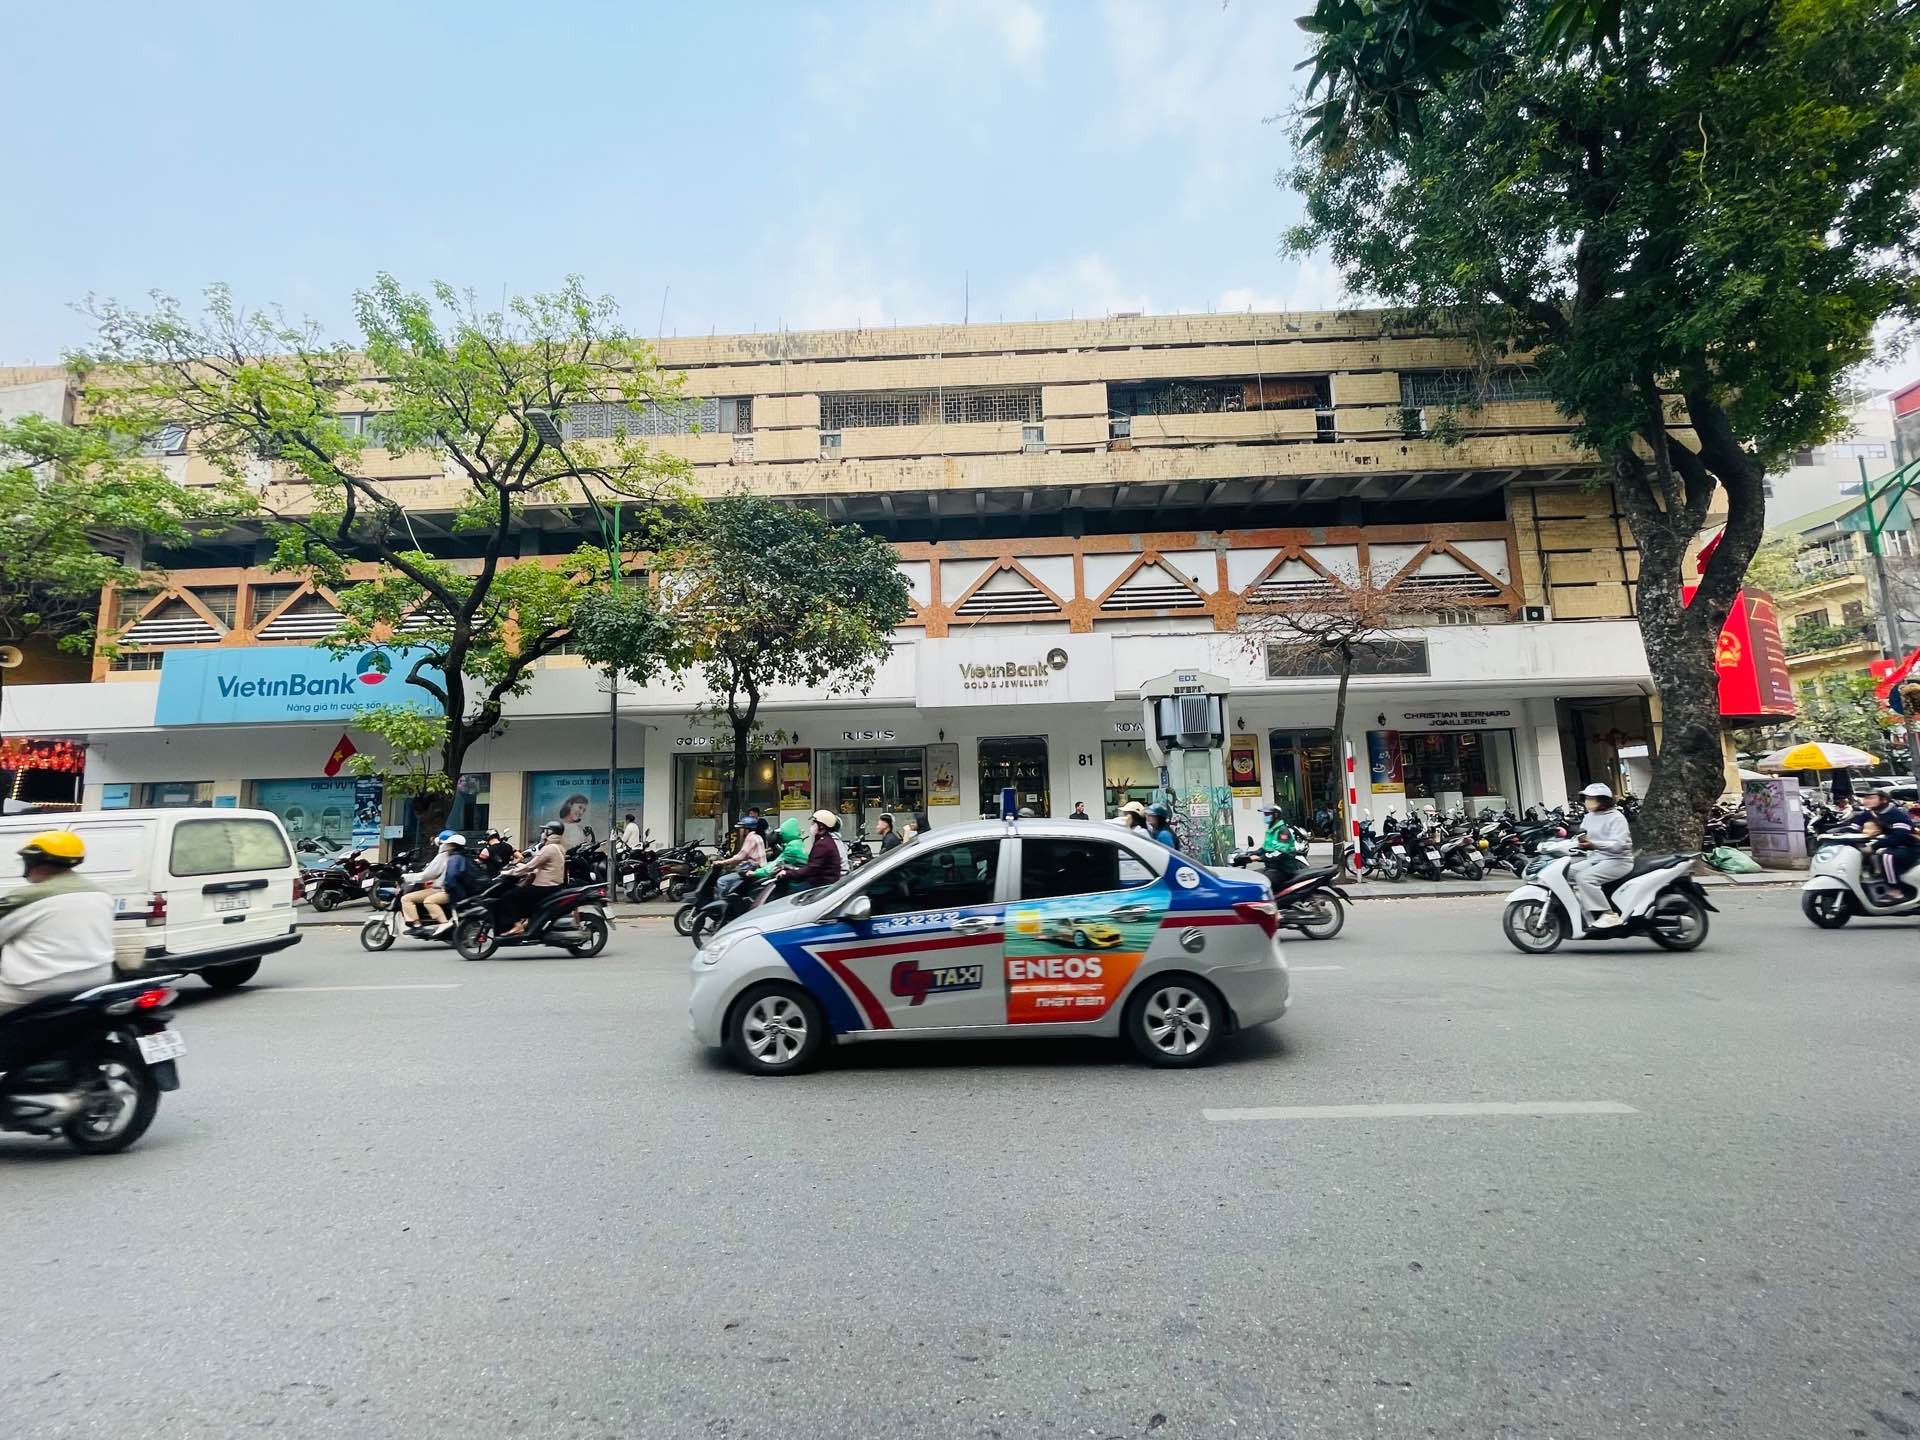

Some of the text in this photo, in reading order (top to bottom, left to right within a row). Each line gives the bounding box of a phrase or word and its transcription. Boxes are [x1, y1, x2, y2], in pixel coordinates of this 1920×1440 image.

[959, 661, 1048, 679] VietinBank
[217, 672, 357, 698] VietinBank
[964, 681, 989, 689] GOLD
[999, 679, 1049, 688] JEWELLERY
[1403, 710, 1511, 720] CHRISTIAN BERNARD
[1115, 722, 1144, 732] ROYA
[1428, 718, 1488, 727] JOAILLERIE
[843, 730, 896, 741] RISIS
[676, 737, 706, 746] GOLD
[1078, 754, 1093, 766] 81
[1008, 957, 1104, 980] ENEOS
[933, 966, 982, 986] TAXI
